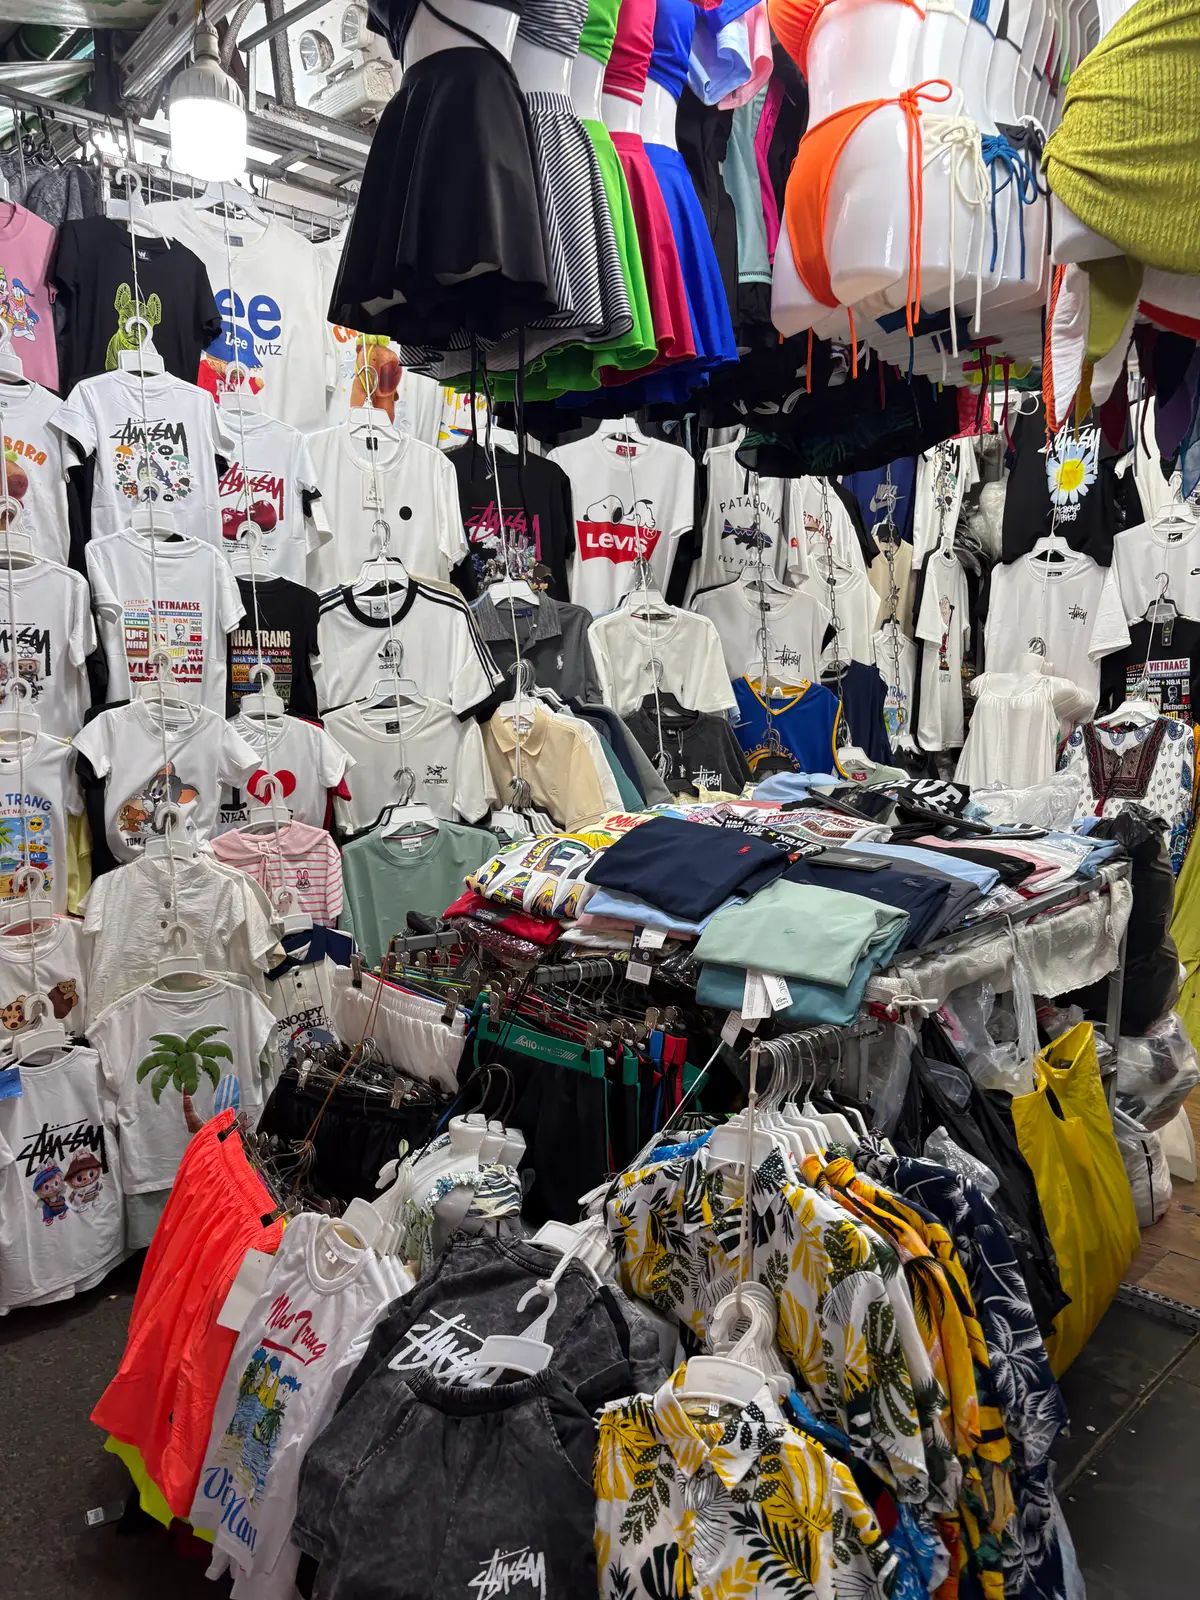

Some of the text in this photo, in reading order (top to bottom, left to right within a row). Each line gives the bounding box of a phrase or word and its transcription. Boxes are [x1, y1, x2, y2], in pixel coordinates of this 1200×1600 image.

[213, 288, 282, 341] ee
[3, 435, 48, 466] BARA
[231, 629, 291, 648] NHA TRANG
[5, 792, 53, 812] TRANG
[125, 837, 142, 847] TOM
[277, 1005, 324, 1032] SNOOPY
